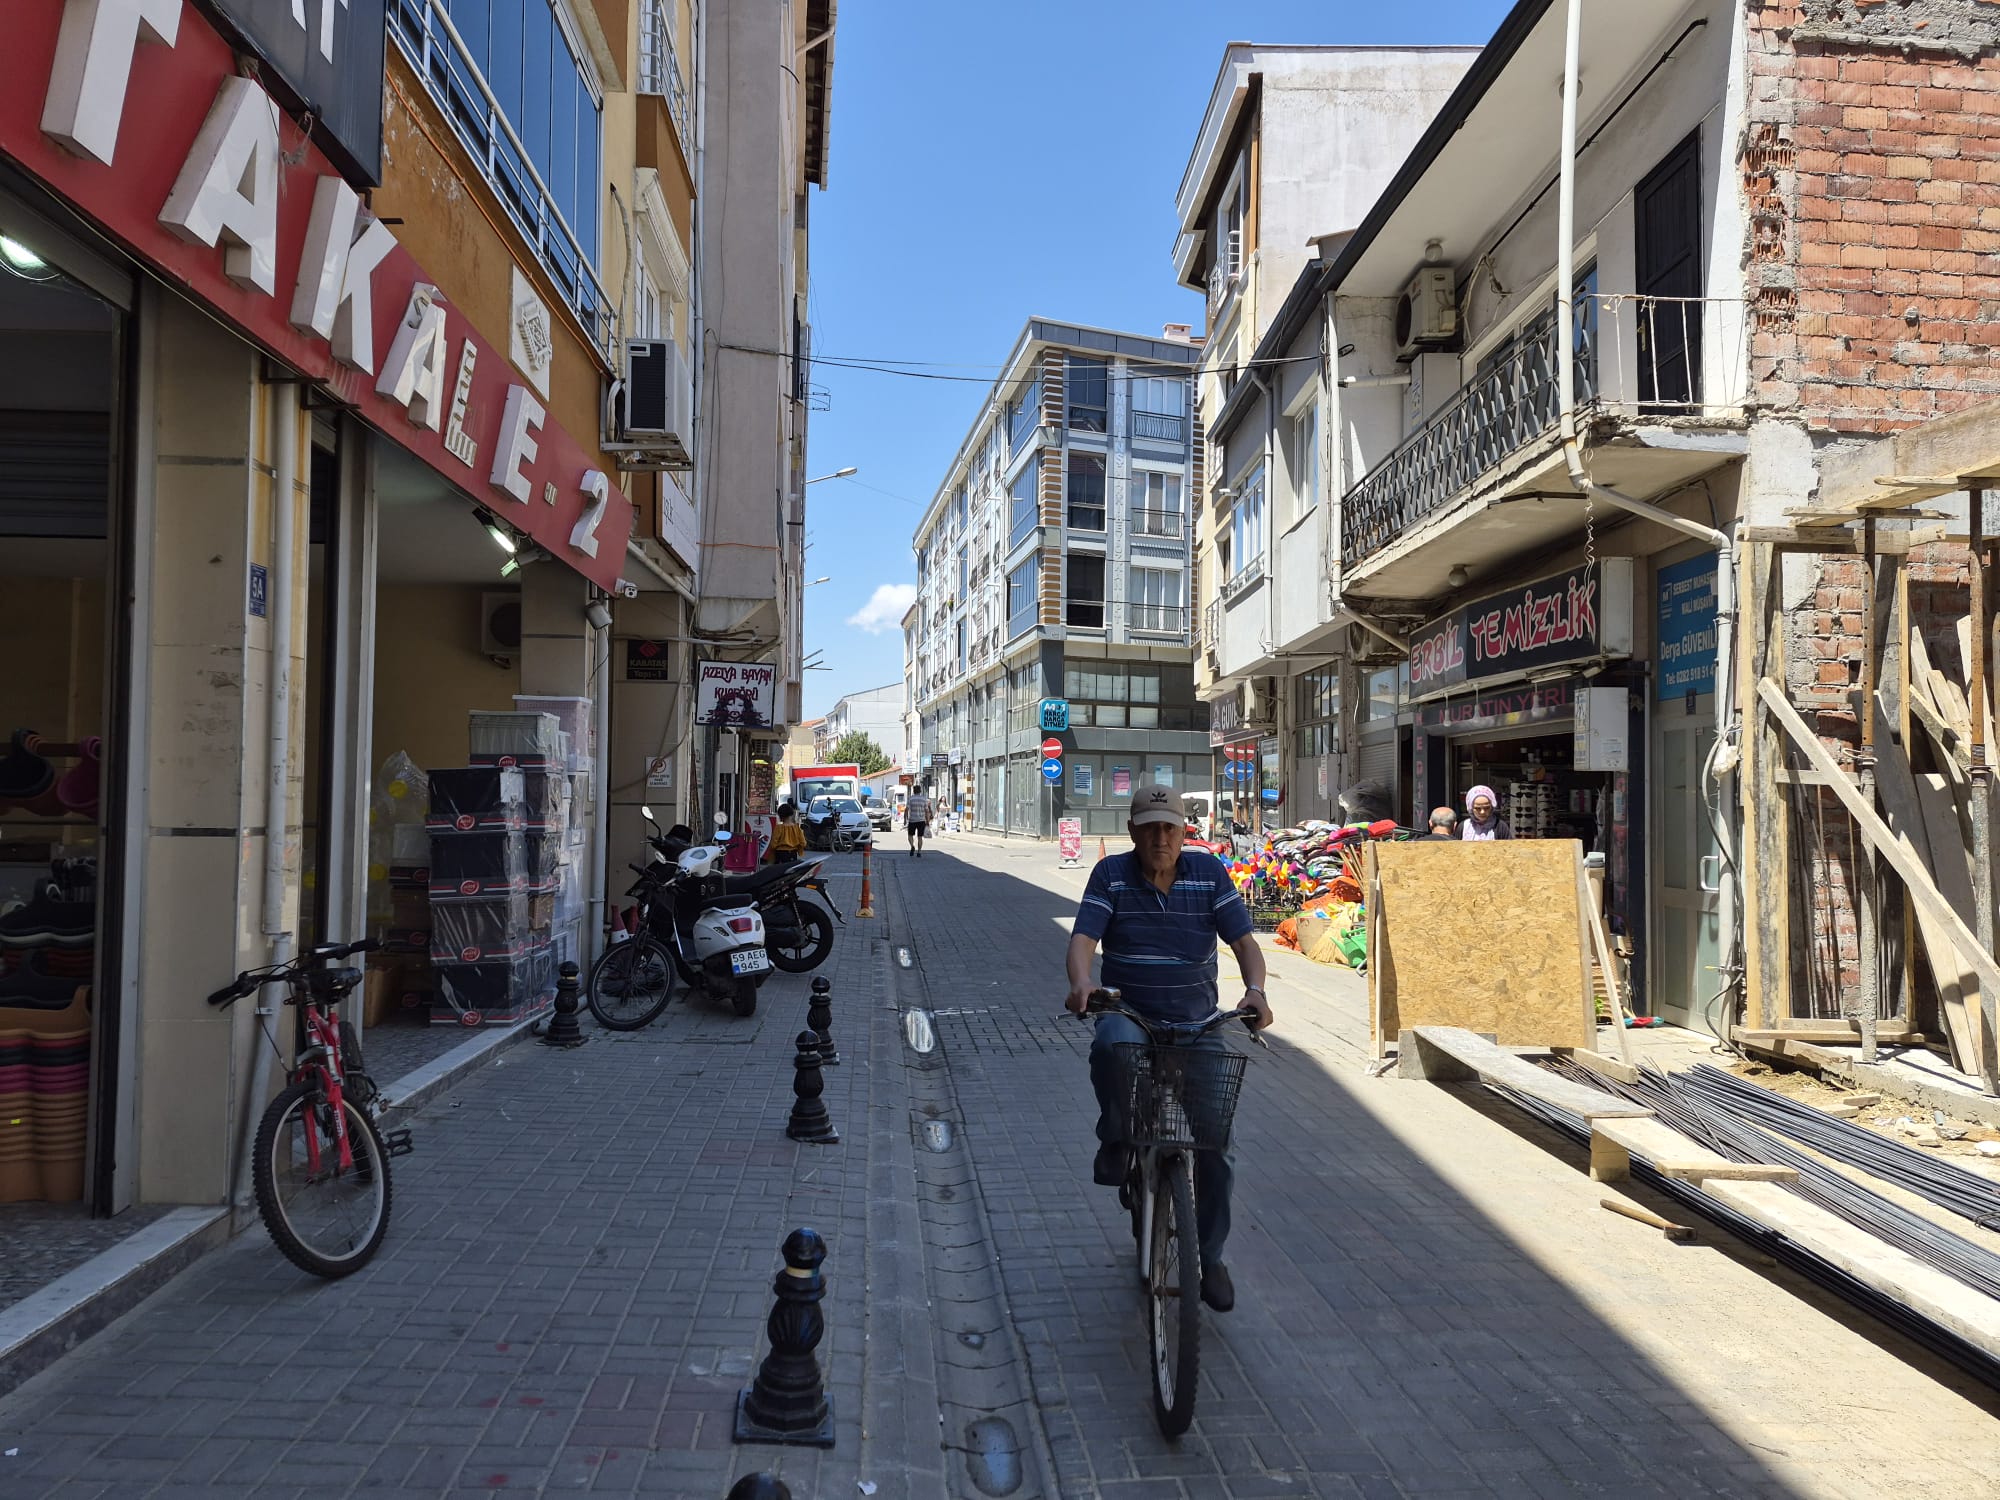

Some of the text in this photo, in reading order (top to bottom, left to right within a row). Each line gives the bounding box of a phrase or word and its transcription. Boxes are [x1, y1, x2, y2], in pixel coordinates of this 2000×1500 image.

[1411, 576, 1597, 684] ERBİL TEMİZLİK
[1660, 641, 1681, 663] Derya
[741, 668, 773, 686] BAYAN
[732, 949, 766, 963] 59 AEG
[740, 960, 760, 972] 945
